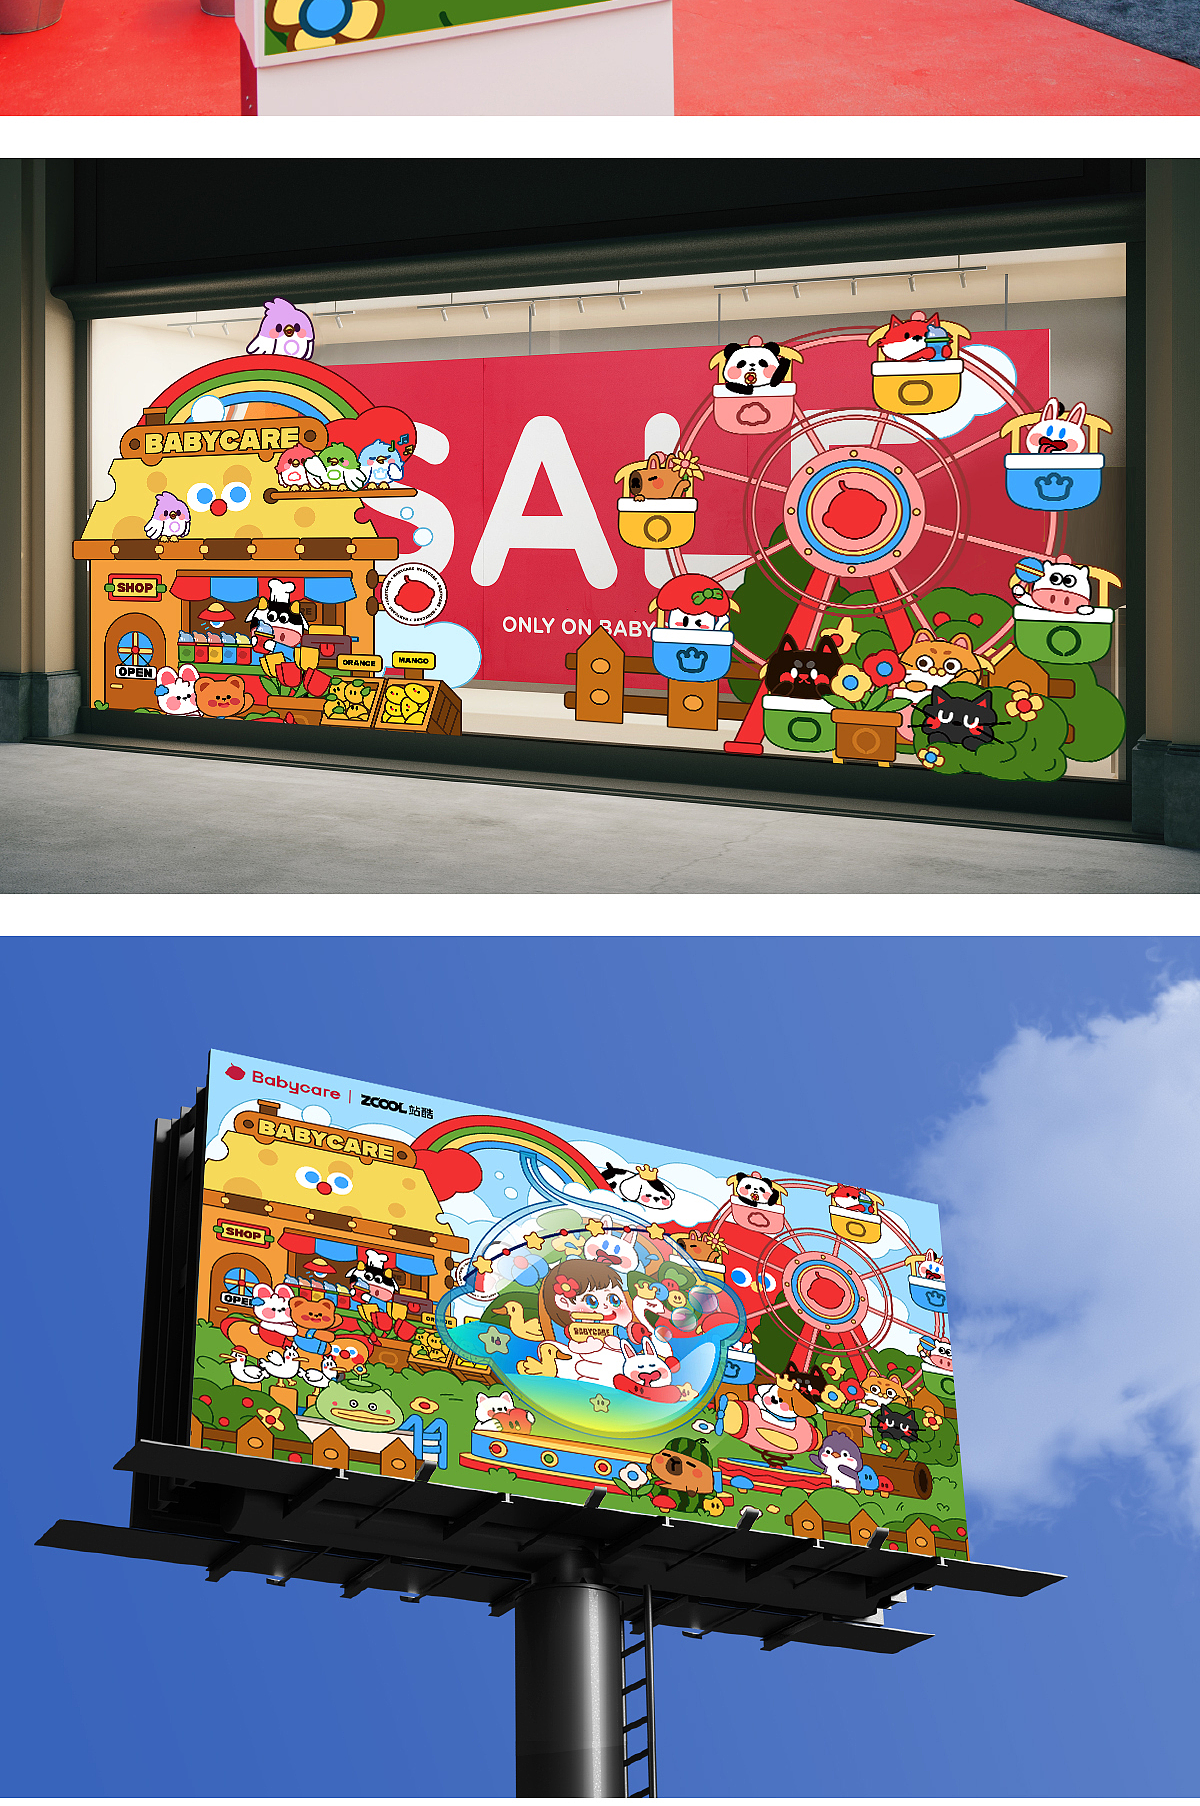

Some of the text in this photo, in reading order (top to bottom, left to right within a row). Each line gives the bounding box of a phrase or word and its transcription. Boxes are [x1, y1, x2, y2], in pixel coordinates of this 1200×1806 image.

[144, 426, 301, 454] BABYCARE
[117, 582, 154, 593] SHOP
[502, 616, 656, 637] ONLY ON BABY
[342, 659, 376, 667] ORANGE
[398, 656, 430, 664] MANGO
[118, 667, 153, 678] OPEN
[252, 1070, 341, 1100] Babycare
[258, 1118, 395, 1162] BABYCARE
[225, 1227, 262, 1240] SHOP
[224, 1294, 252, 1306] OPE
